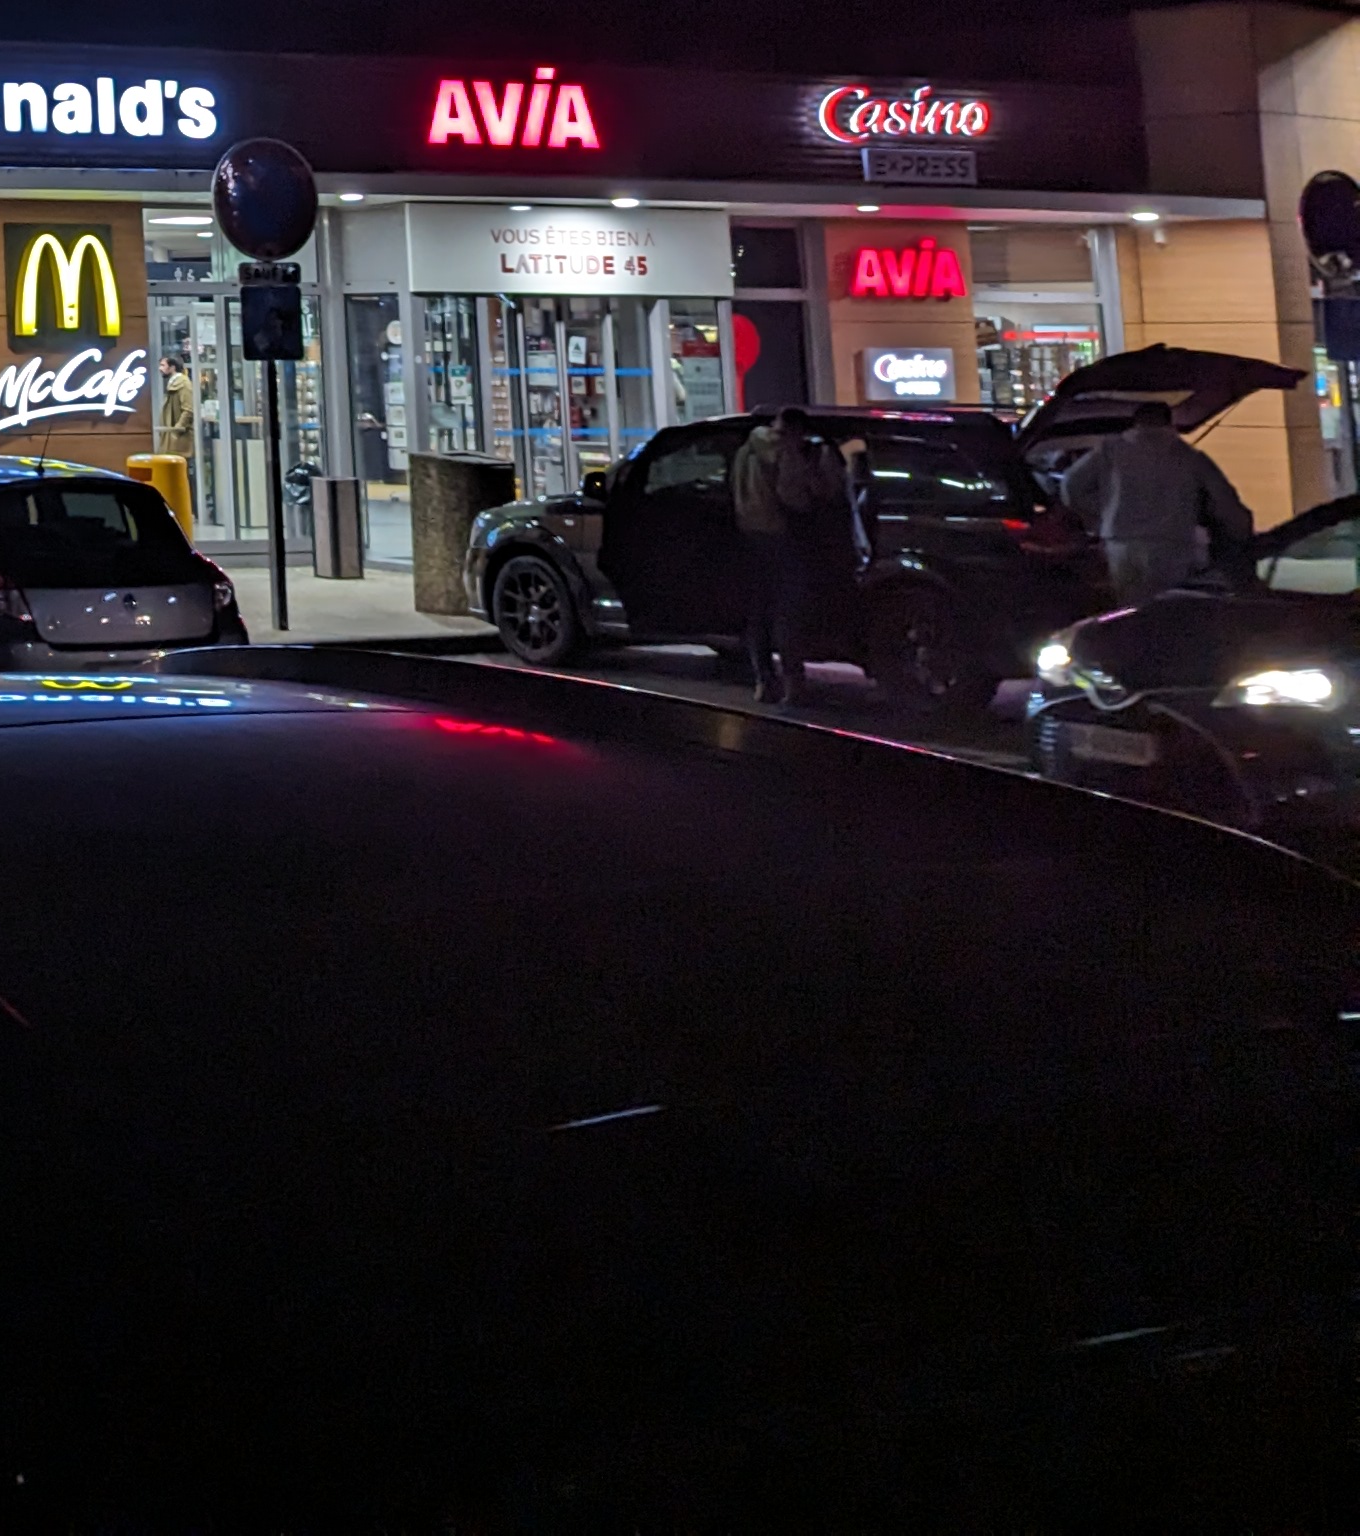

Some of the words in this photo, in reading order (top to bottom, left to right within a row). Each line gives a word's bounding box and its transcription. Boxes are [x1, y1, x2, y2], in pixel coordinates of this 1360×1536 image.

[818, 84, 991, 144] Casino
[874, 154, 970, 178] EXPRESS
[490, 228, 541, 245] VOUS
[546, 225, 592, 246] ÊTES
[596, 230, 640, 247] BIEN
[500, 253, 616, 275] LATITUDE
[624, 255, 649, 276] 45
[874, 353, 948, 383] Casino
